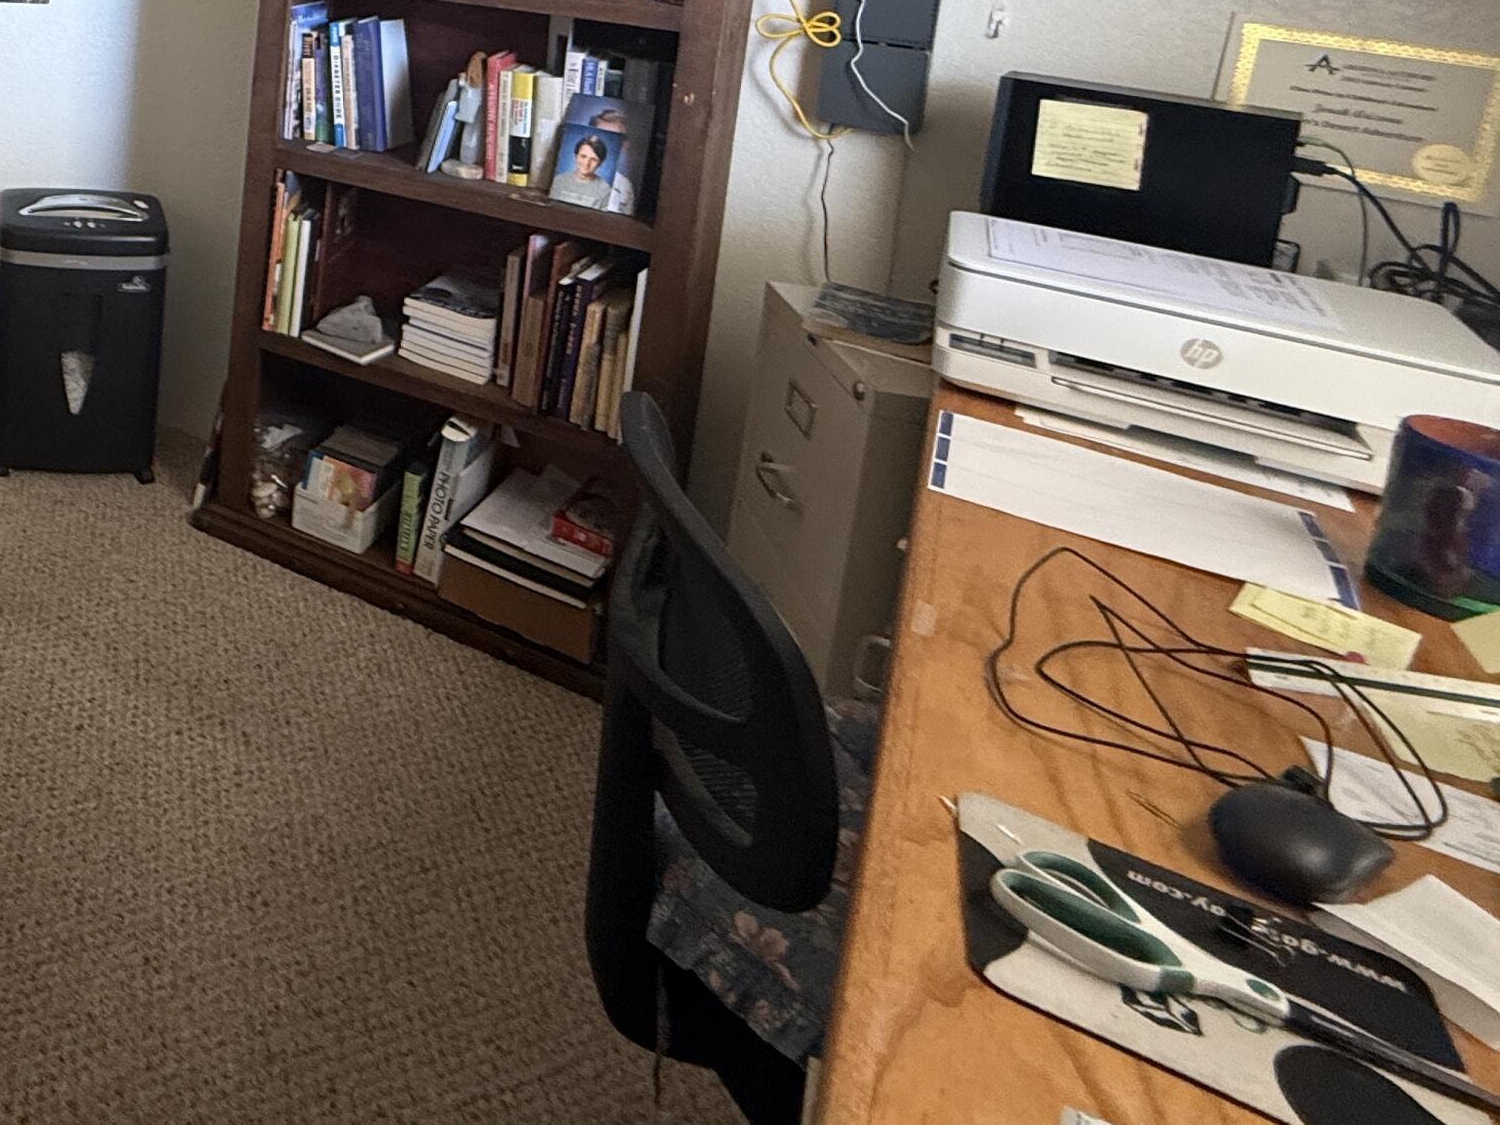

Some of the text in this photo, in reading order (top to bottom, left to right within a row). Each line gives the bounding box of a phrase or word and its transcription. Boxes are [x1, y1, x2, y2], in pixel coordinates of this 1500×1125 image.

[1182, 339, 1221, 369] hp
[431, 472, 450, 515] PHOTO
[422, 517, 440, 550] PAPER
